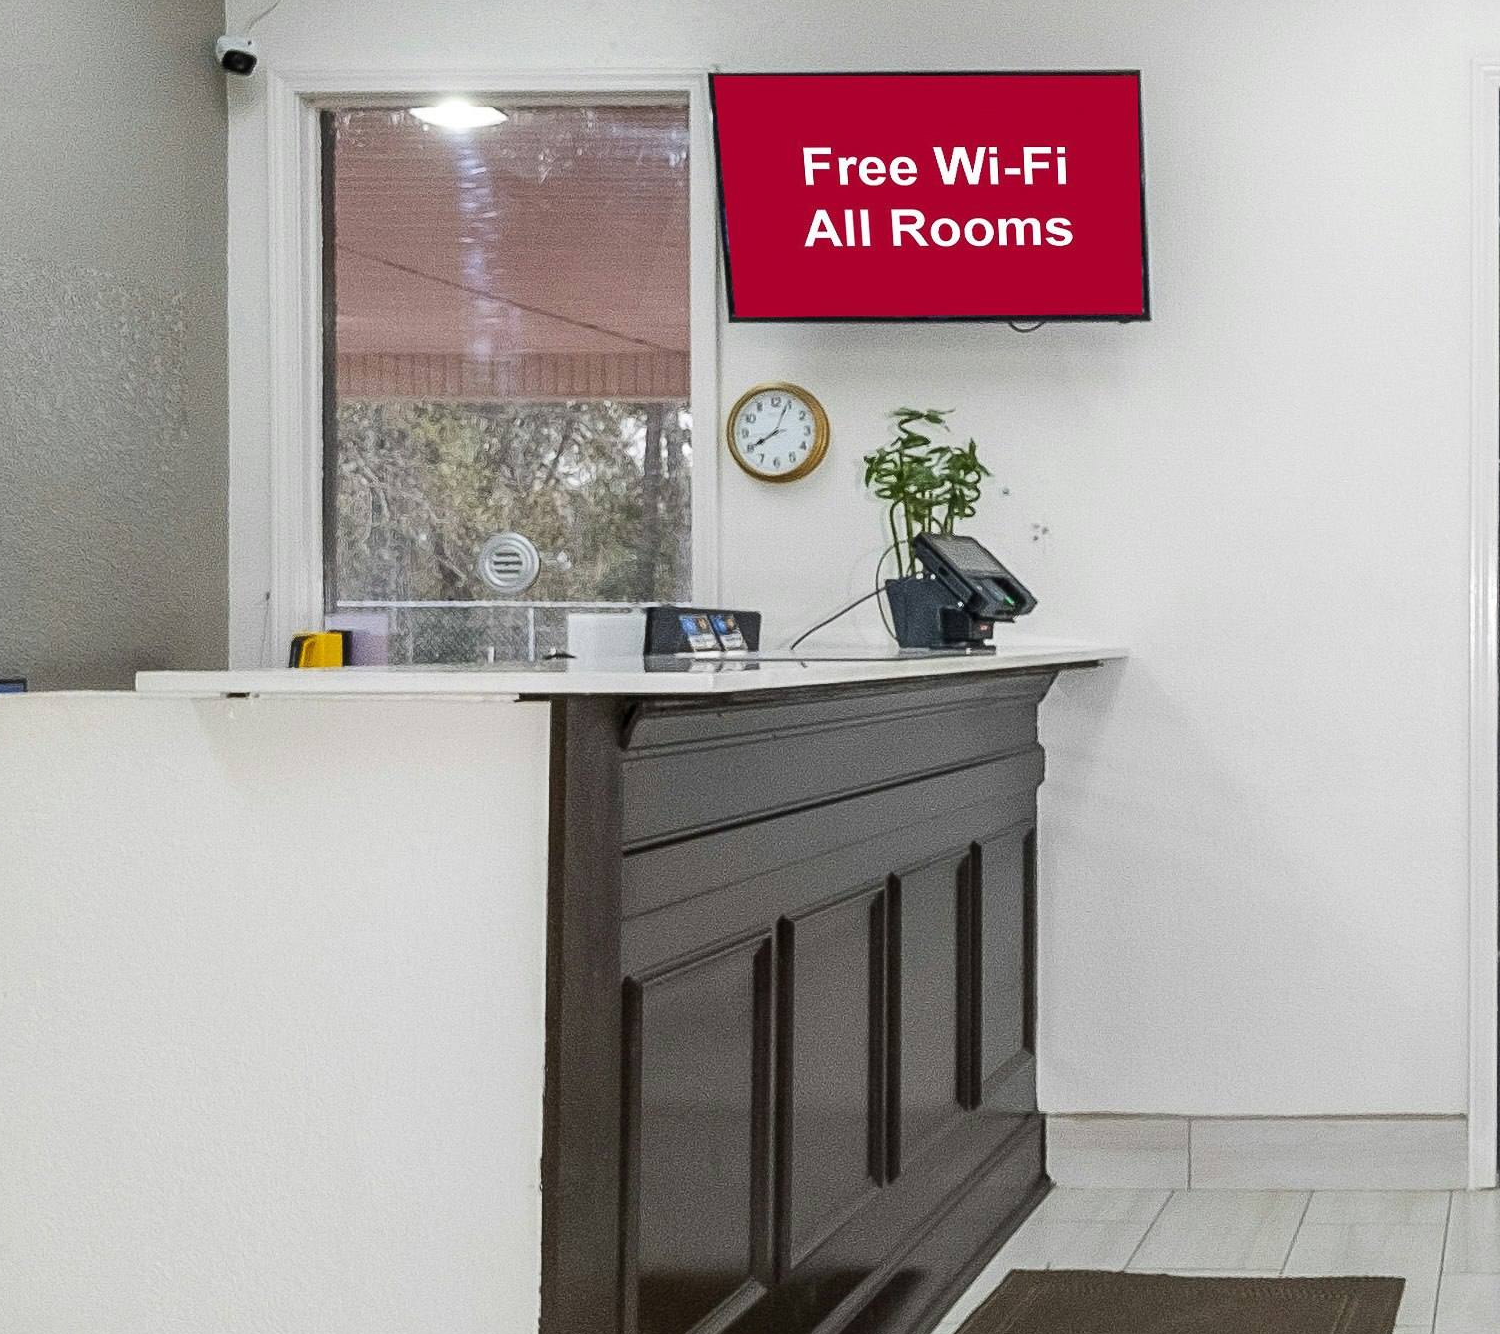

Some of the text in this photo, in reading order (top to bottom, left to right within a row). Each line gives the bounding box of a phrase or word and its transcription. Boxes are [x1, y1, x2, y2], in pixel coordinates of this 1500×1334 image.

[803, 146, 1067, 187] Free Wi-Fi
[804, 208, 1074, 248] All Rooms
